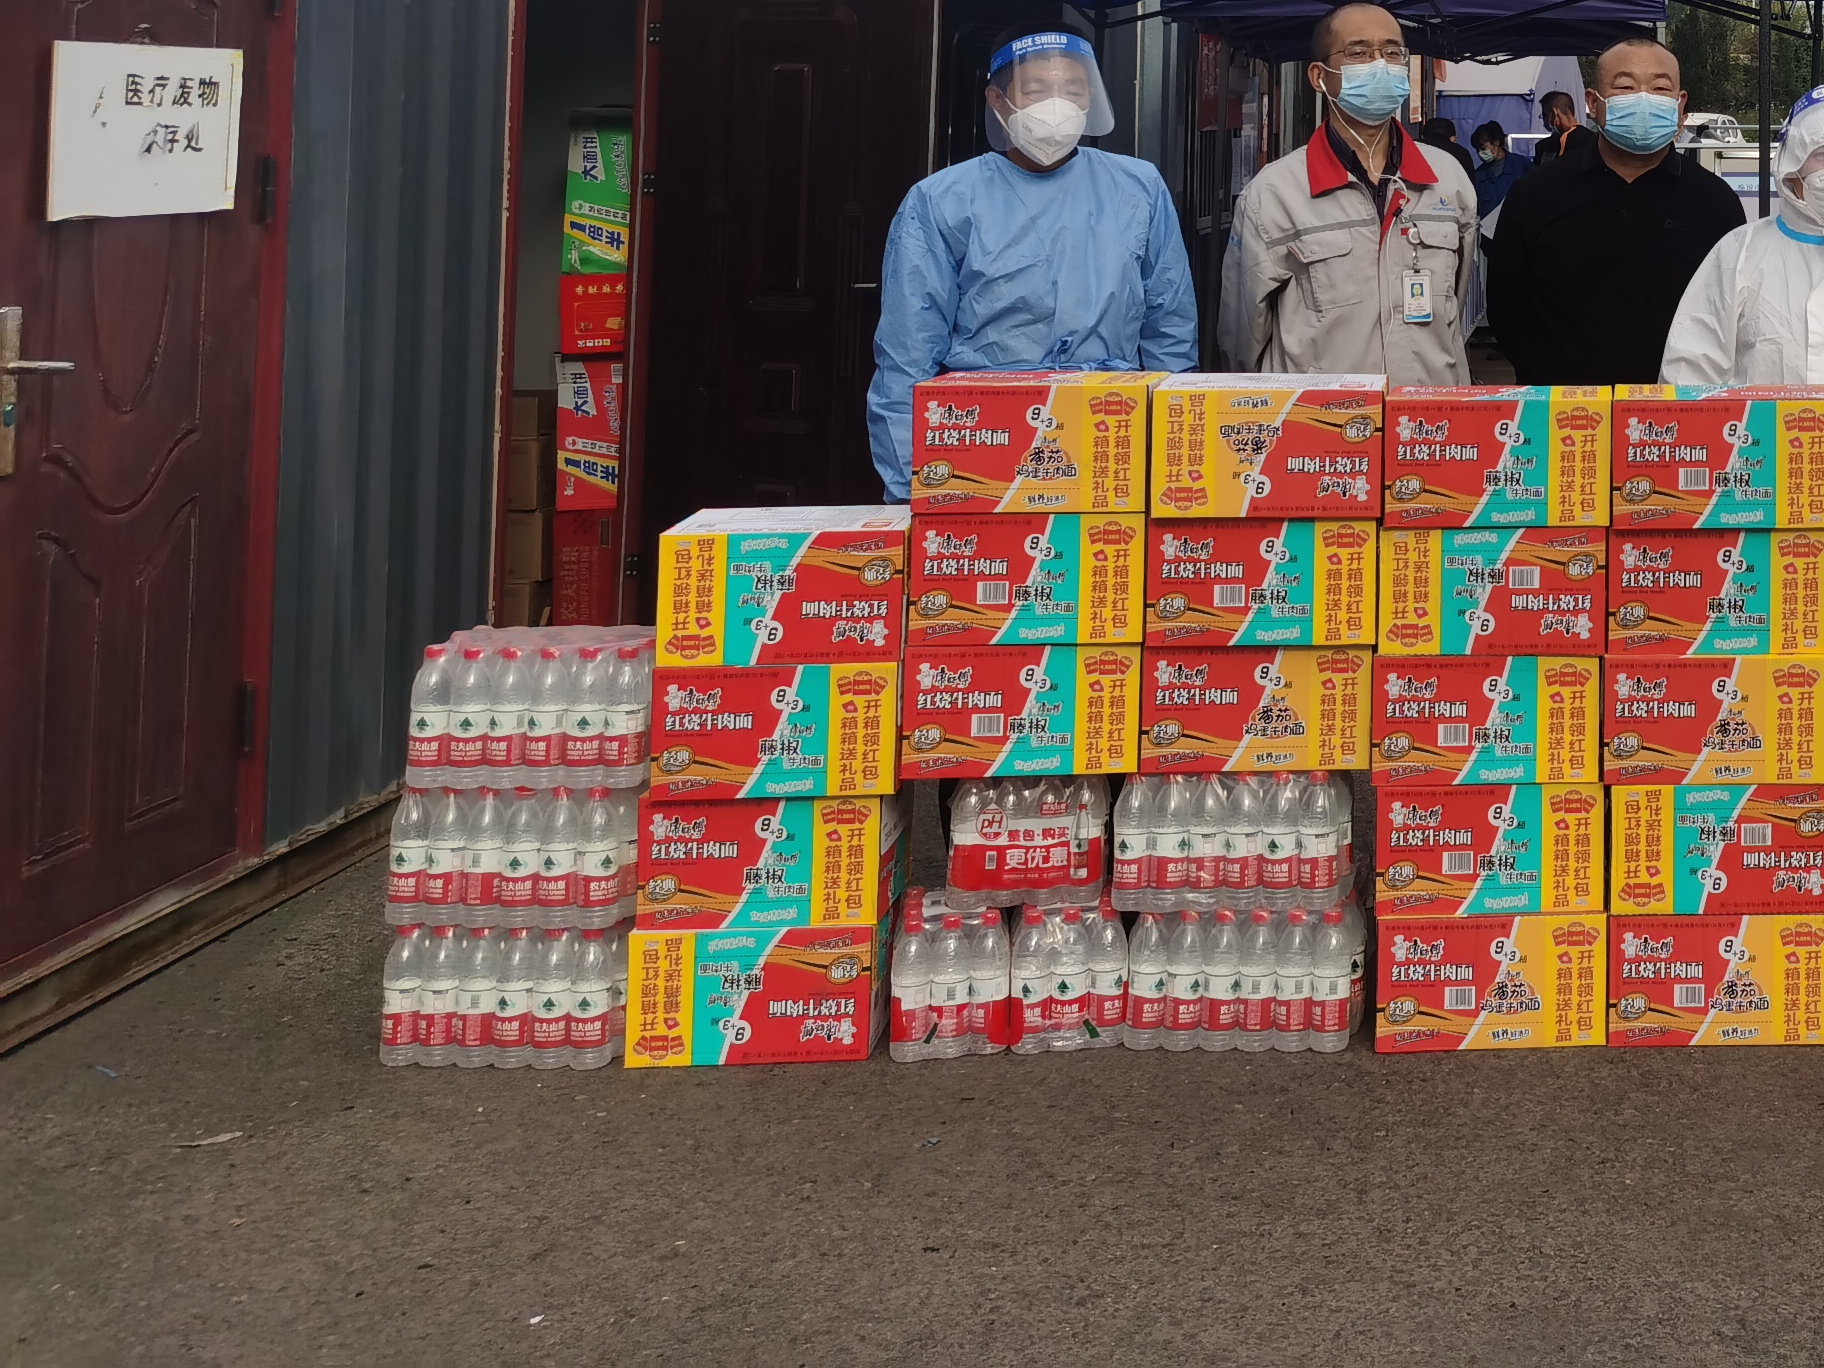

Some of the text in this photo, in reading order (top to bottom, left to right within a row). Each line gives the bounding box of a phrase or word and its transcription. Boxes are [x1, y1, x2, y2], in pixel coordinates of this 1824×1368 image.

[1012, 37, 1033, 52] FACE
[1034, 35, 1068, 45] SHIELD
[582, 136, 599, 181] 大面饼
[573, 372, 590, 416] 大面饼
[926, 429, 1010, 446] 红烧牛肉面
[1187, 394, 1205, 466] 箱箱送礼品
[1030, 448, 1064, 466] 番茄
[1092, 436, 1110, 508] 箱箱送礼品
[1113, 419, 1131, 497] 开箱领红包
[1287, 456, 1368, 473] 红烧牛肉面
[1397, 444, 1478, 461] 红烧牛肉面
[1580, 434, 1597, 512] 开箱领红包
[1627, 445, 1707, 462] 红烧牛肉面
[1559, 450, 1576, 522] 箱箱送礼品
[1788, 451, 1804, 523] 箱箱送礼品
[695, 539, 715, 614] 箱箱送礼品
[924, 558, 1007, 576] 红烧牛肉面
[1111, 548, 1130, 628] 开箱领红包
[1162, 561, 1243, 579] 红烧牛肉面
[1622, 570, 1701, 588] 红烧牛肉面
[672, 549, 693, 631] 开箱领红包
[801, 600, 887, 618] 红烧牛肉面
[1014, 585, 1053, 603] 藤椒
[1346, 552, 1364, 630] 开箱领红包
[1511, 594, 1591, 611] 红烧牛肉面
[1802, 561, 1819, 639] 开箱领红包
[1782, 577, 1798, 649] 箱箱送礼品
[917, 691, 1002, 709] 红烧牛肉面
[1107, 679, 1126, 759] 开箱领红包
[1156, 688, 1238, 706] 红烧牛肉面
[1340, 677, 1358, 755] 开箱领红包
[1386, 701, 1467, 718] 红烧牛肉面
[1616, 701, 1696, 718] 红烧牛肉面
[665, 712, 753, 731] 红烧牛肉面
[861, 699, 881, 780] 开箱领红包
[1086, 695, 1104, 769] 箱箱送礼品
[1319, 694, 1337, 766] 箱箱送礼品
[1474, 727, 1511, 745] 藤椒
[1548, 706, 1565, 779] 箱箱送礼品
[1569, 690, 1586, 769] 开箱领红包
[1797, 691, 1814, 769] 开箱领红包
[760, 739, 800, 757] 藤椒
[787, 756, 822, 767] 牛肉面
[839, 716, 858, 791] 箱箱送礼品
[980, 814, 1004, 832] pH
[1391, 829, 1472, 846] 红烧牛肉面
[1624, 800, 1641, 879] 开箱领红包
[1645, 790, 1661, 863] 箱箱送礼品
[651, 841, 738, 859] 红烧牛肉面
[845, 828, 865, 909] 开箱领红包
[1004, 847, 1069, 869] 更优惠
[1553, 833, 1570, 907] 箱箱送礼品
[1574, 817, 1591, 896] 开箱领红包
[1743, 851, 1823, 868] 红烧牛肉面
[663, 938, 682, 1014] 箱箱送礼品
[1392, 963, 1474, 983] 红烧牛肉面
[1576, 949, 1594, 1031] 开箱领红包
[1623, 961, 1703, 979] 红烧牛肉面
[1723, 980, 1756, 999] 番茄
[768, 998, 855, 1017] 红烧牛肉面
[1784, 968, 1801, 1041] 箱箱送礼品
